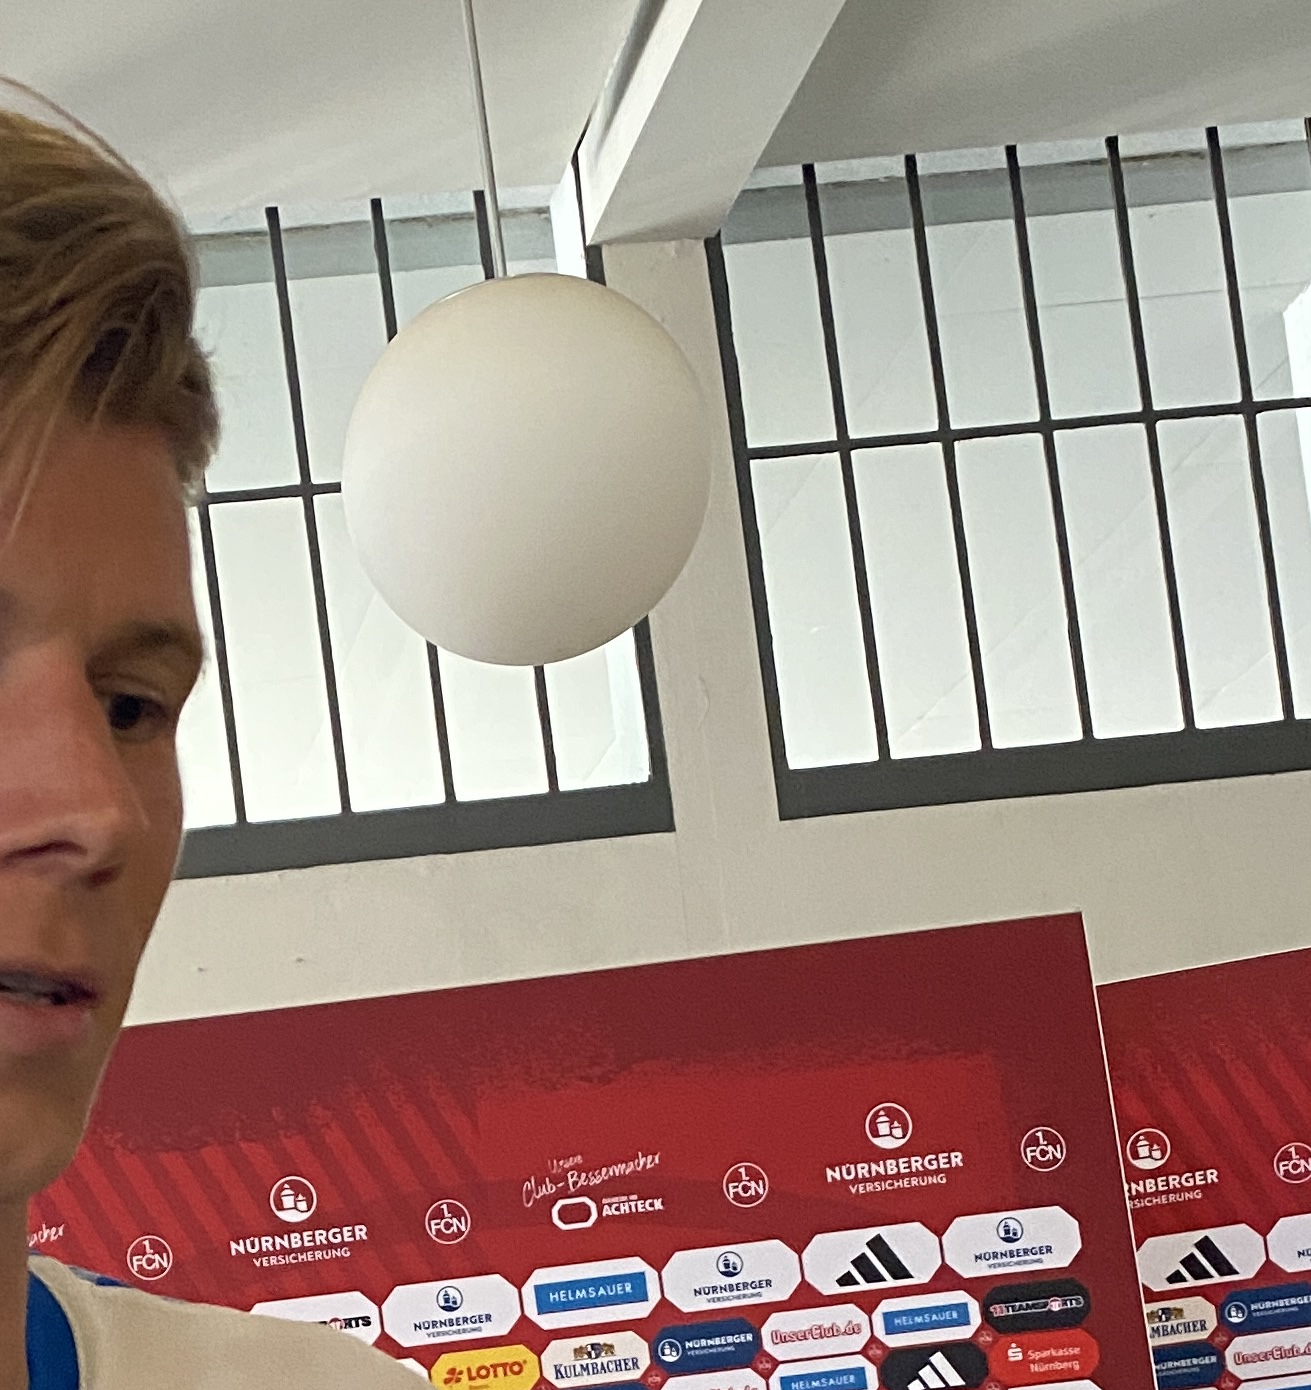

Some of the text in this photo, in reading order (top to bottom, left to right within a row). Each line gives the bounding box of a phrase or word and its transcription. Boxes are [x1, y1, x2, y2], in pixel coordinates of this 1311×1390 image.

[1026, 1144, 1062, 1163] FCN
[825, 1151, 964, 1183] NÜRNBERGER
[1279, 1160, 1311, 1177] FCN
[728, 1179, 764, 1198] FCN
[849, 1173, 947, 1195] VERSICHERUNG
[1125, 1168, 1219, 1197] NBERGER
[602, 1198, 664, 1217] ACHTECK
[1128, 1189, 1203, 1209] RSICHERUNG
[430, 1217, 467, 1236] FCN
[229, 1224, 369, 1257] NÜRNBERGER
[132, 1252, 169, 1272] FCN
[252, 1247, 351, 1268] VERSICHERUNG
[974, 1245, 1054, 1263] NÜRNBERGER
[549, 1281, 633, 1304] HELMSAUER
[693, 1278, 773, 1298] NÜRNBERGER
[413, 1313, 493, 1332] NÜRNBERGER
[894, 1310, 959, 1327] HELMSAUER
[771, 1320, 862, 1345] UnserClub.de
[1150, 1319, 1208, 1339] MBACHER
[1027, 1345, 1081, 1361] Sparkasse
[1233, 1342, 1311, 1366] UnserClub.d
[467, 1360, 524, 1381] LOTTO
[554, 1357, 640, 1380] KULMBACHER
[1029, 1358, 1081, 1375] Nürnberg
[791, 1374, 856, 1390] HELMSAUER
